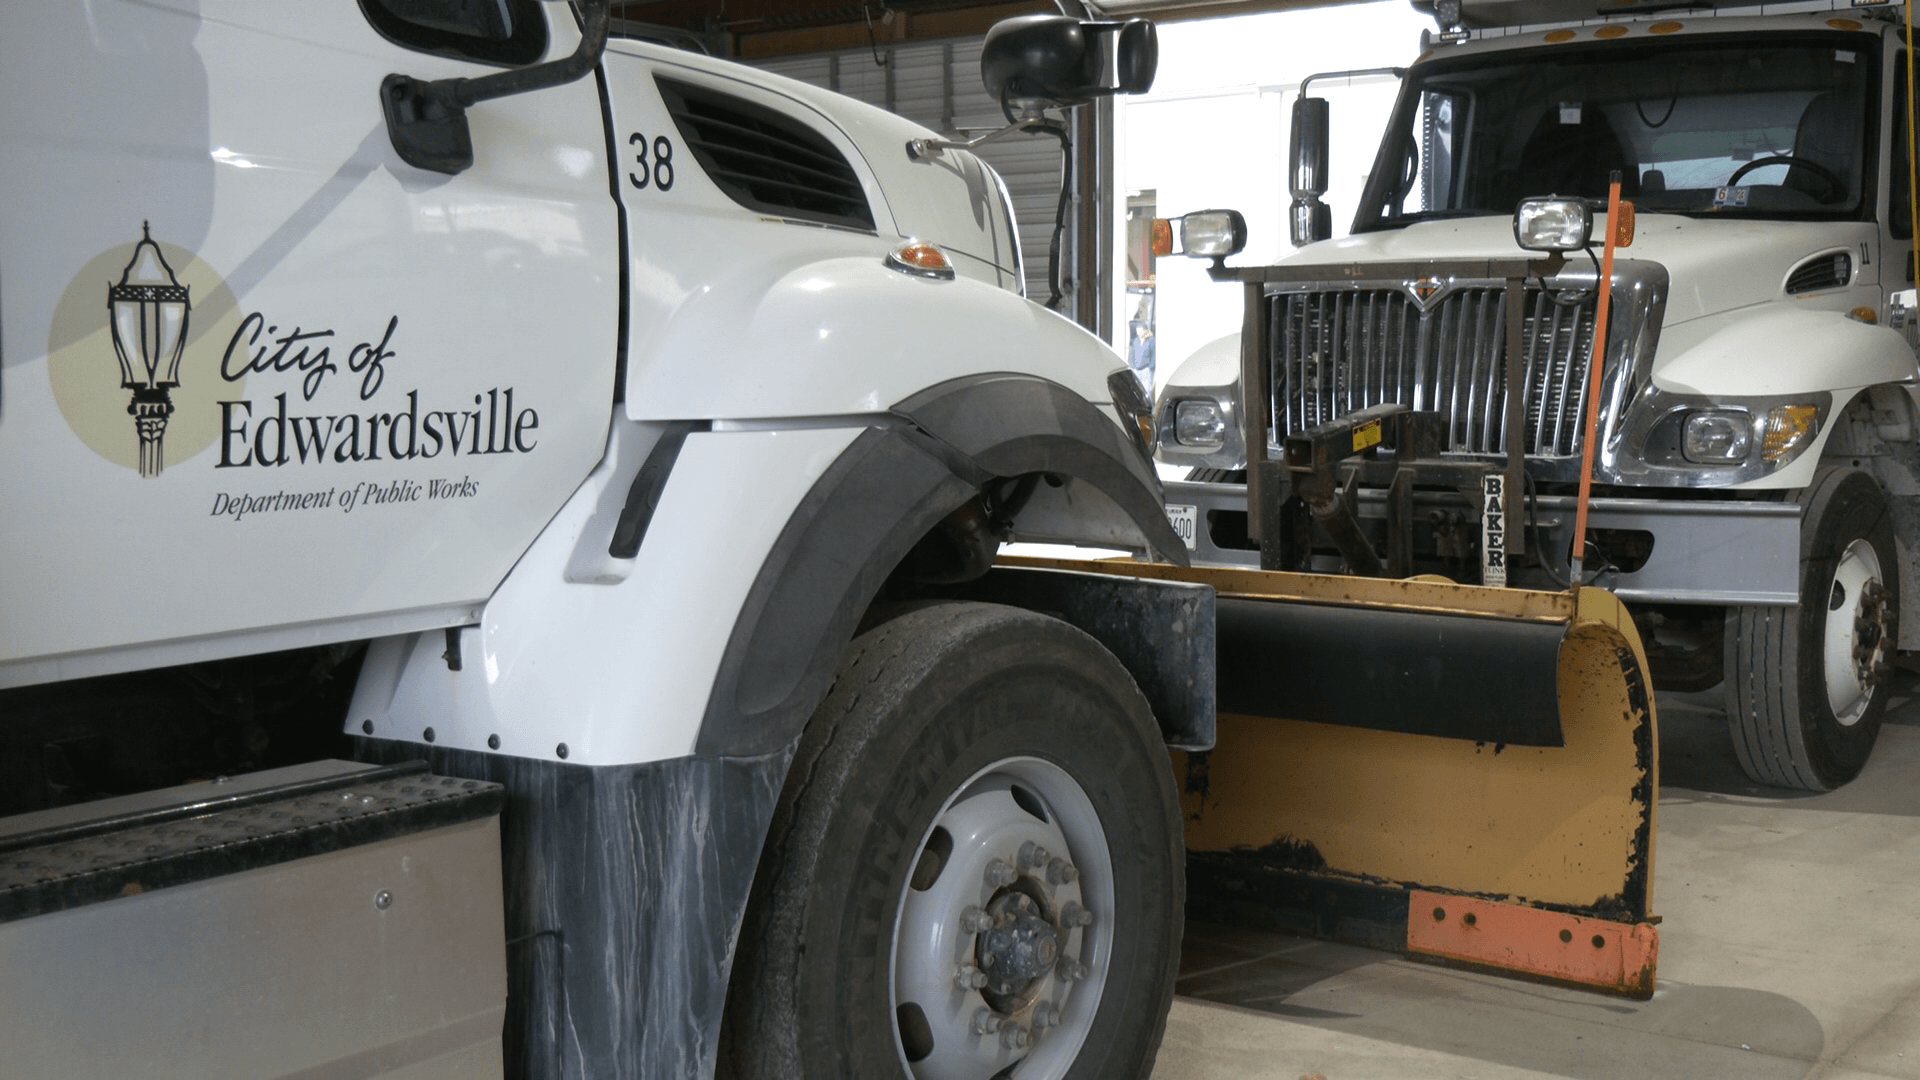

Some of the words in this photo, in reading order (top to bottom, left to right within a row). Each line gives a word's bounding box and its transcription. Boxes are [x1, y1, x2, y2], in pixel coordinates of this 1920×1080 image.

[628, 131, 675, 193] 38
[221, 311, 337, 402] City
[348, 314, 399, 402] of
[214, 386, 541, 469] Edwardsville
[210, 484, 336, 522] Department
[338, 481, 364, 514] of
[362, 478, 422, 505] Public
[428, 476, 480, 499] Works
[1168, 517, 1192, 539] 600
[1486, 477, 1503, 567] BAKER
